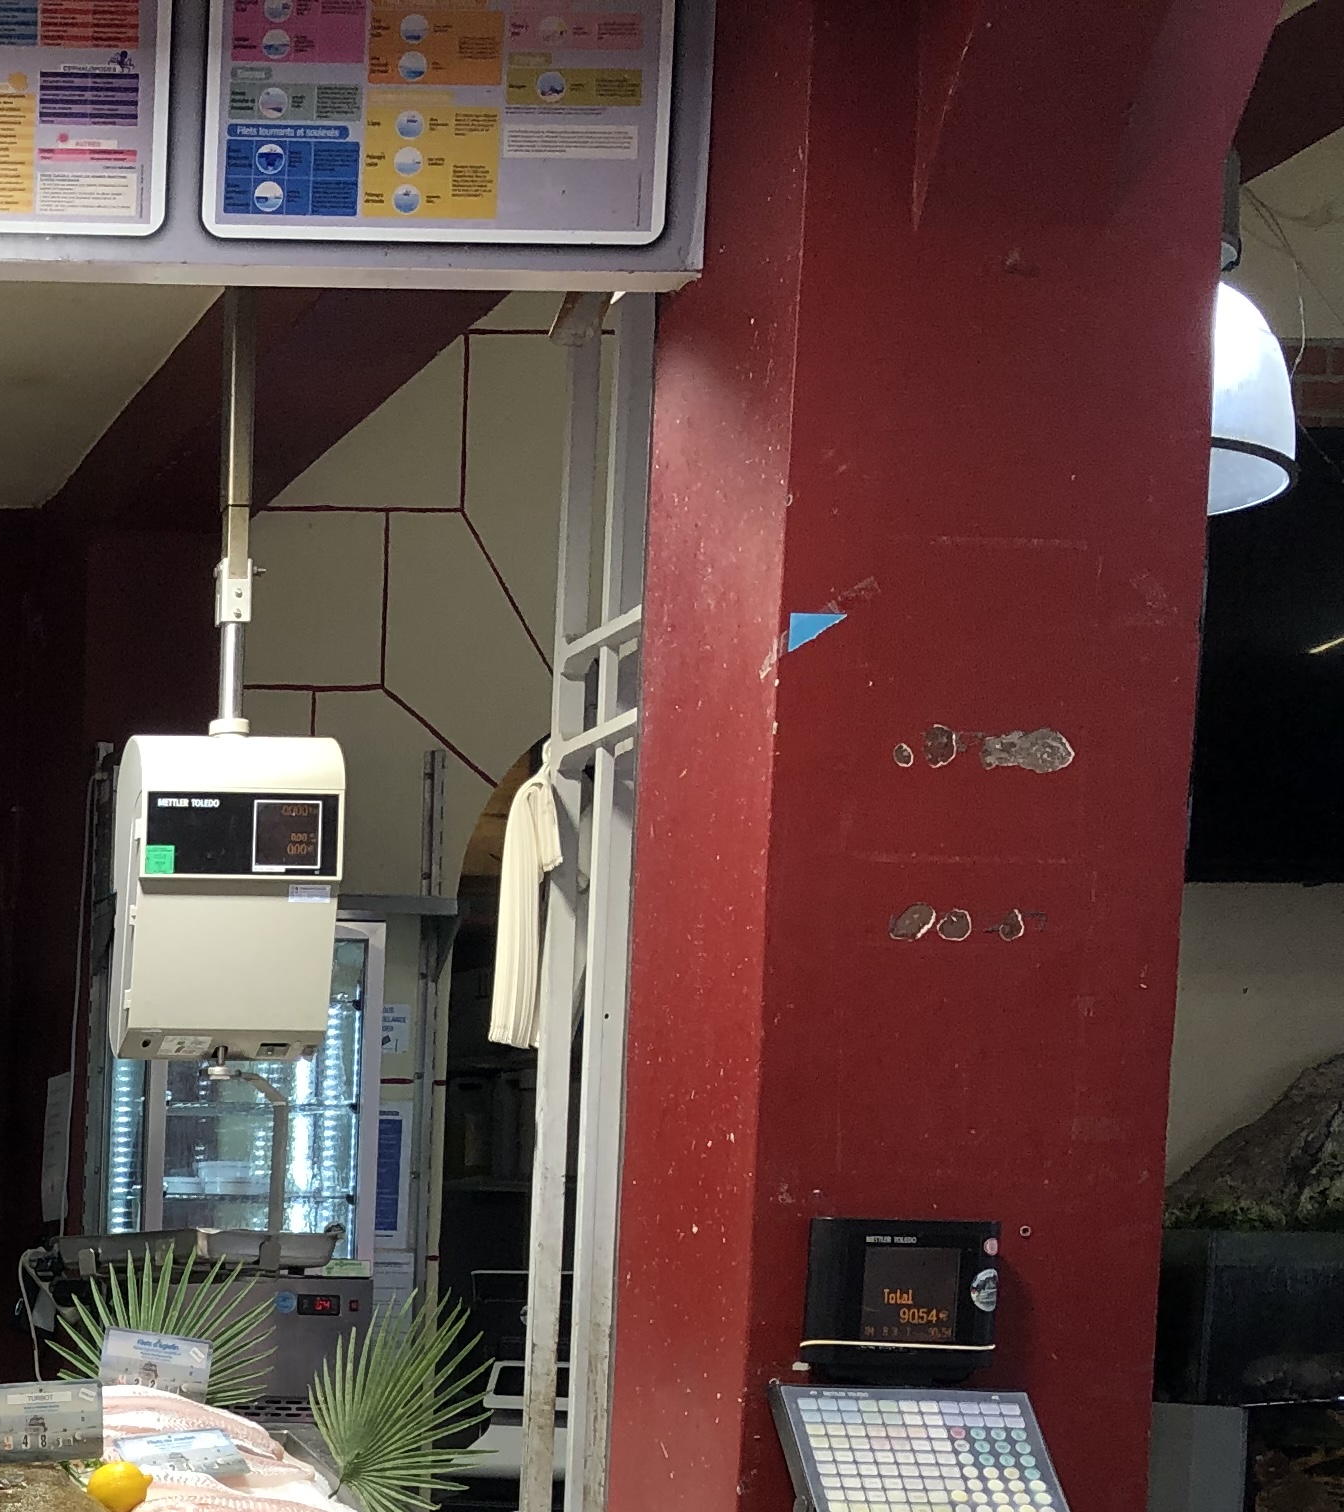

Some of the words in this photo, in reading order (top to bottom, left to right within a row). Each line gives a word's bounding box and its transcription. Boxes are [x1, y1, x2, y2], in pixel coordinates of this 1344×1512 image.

[157, 798, 189, 808] METTLER
[191, 798, 220, 808] TOLEDO
[865, 1235, 892, 1243] METTLER
[894, 1236, 917, 1244] TOLEDO
[882, 1289, 913, 1305] Total
